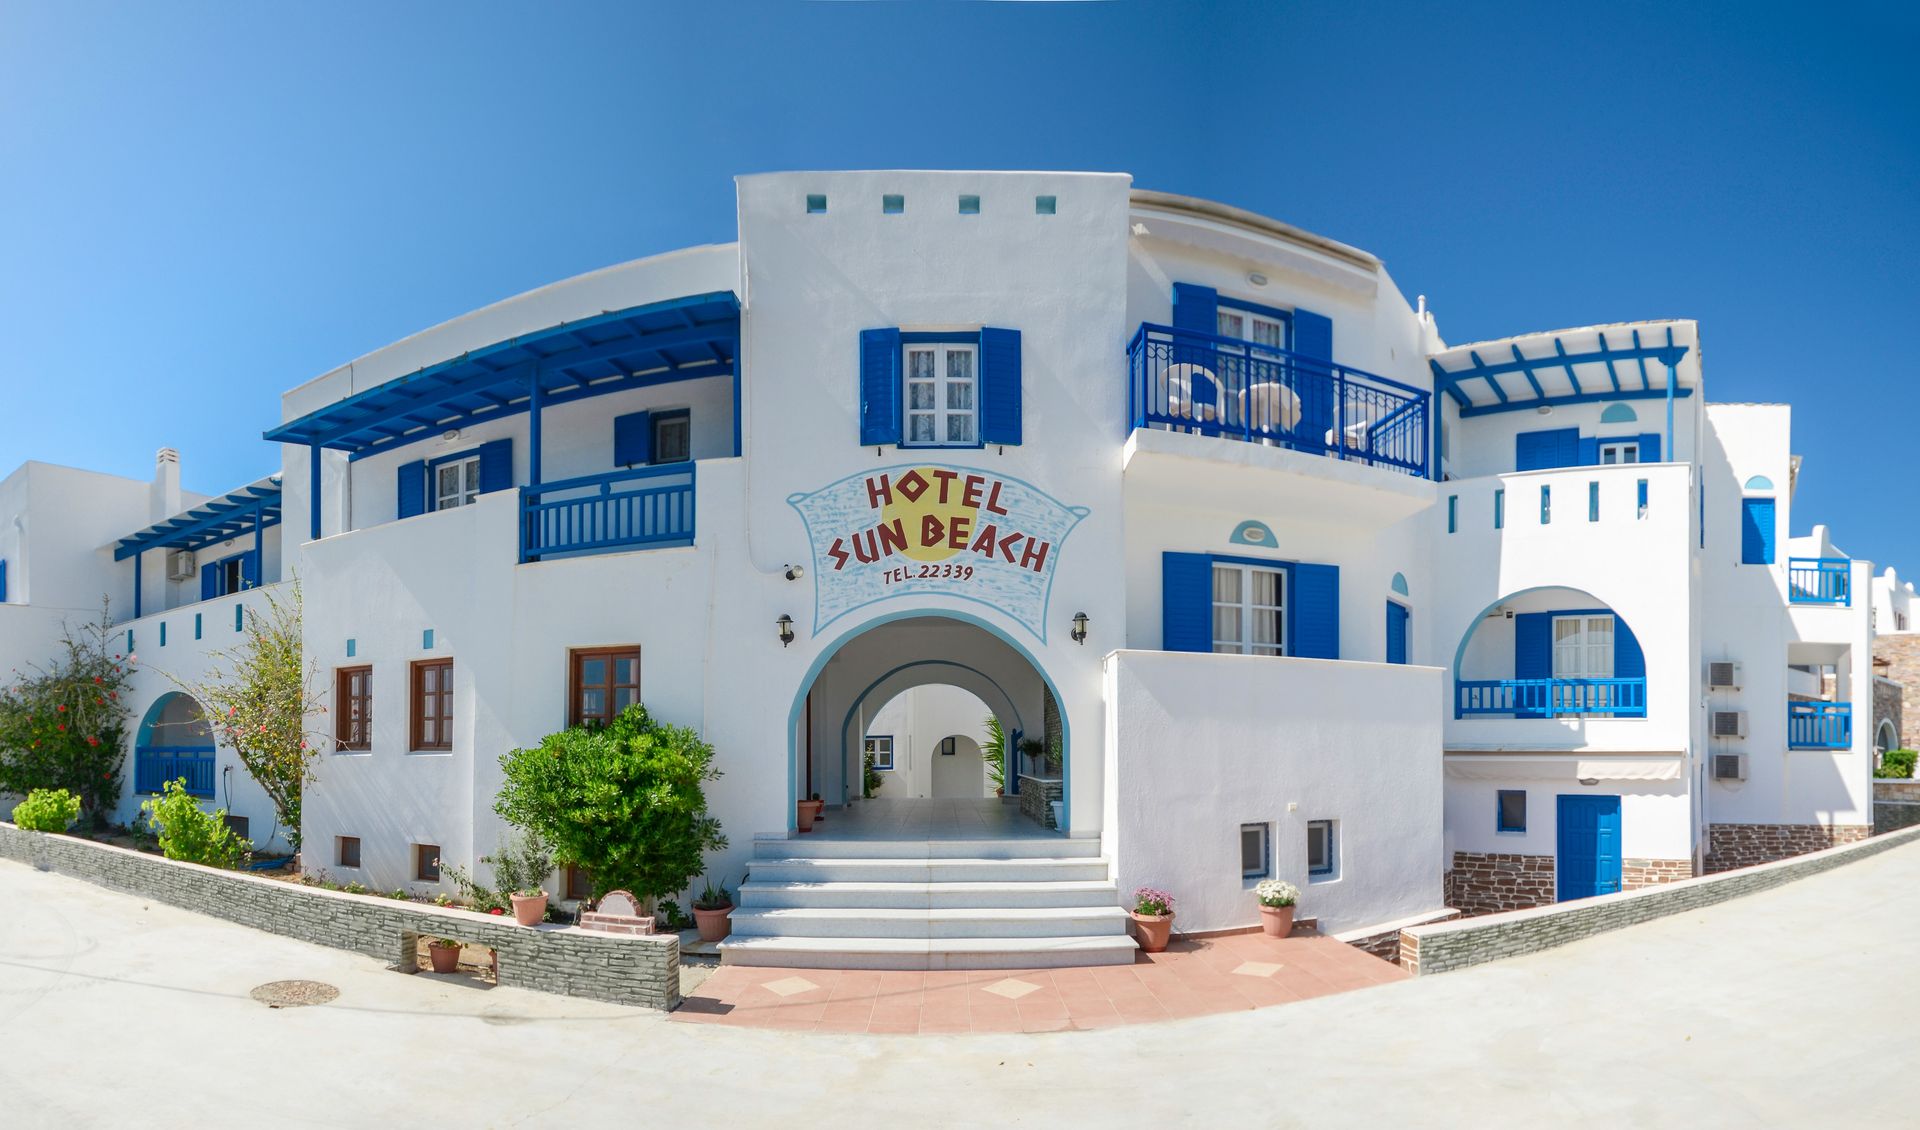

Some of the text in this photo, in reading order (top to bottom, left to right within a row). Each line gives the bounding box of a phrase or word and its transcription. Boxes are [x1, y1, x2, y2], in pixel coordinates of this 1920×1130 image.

[866, 469, 1007, 515] HOTEL
[828, 514, 1050, 573] SUN BEACH
[917, 564, 974, 581] 22339
